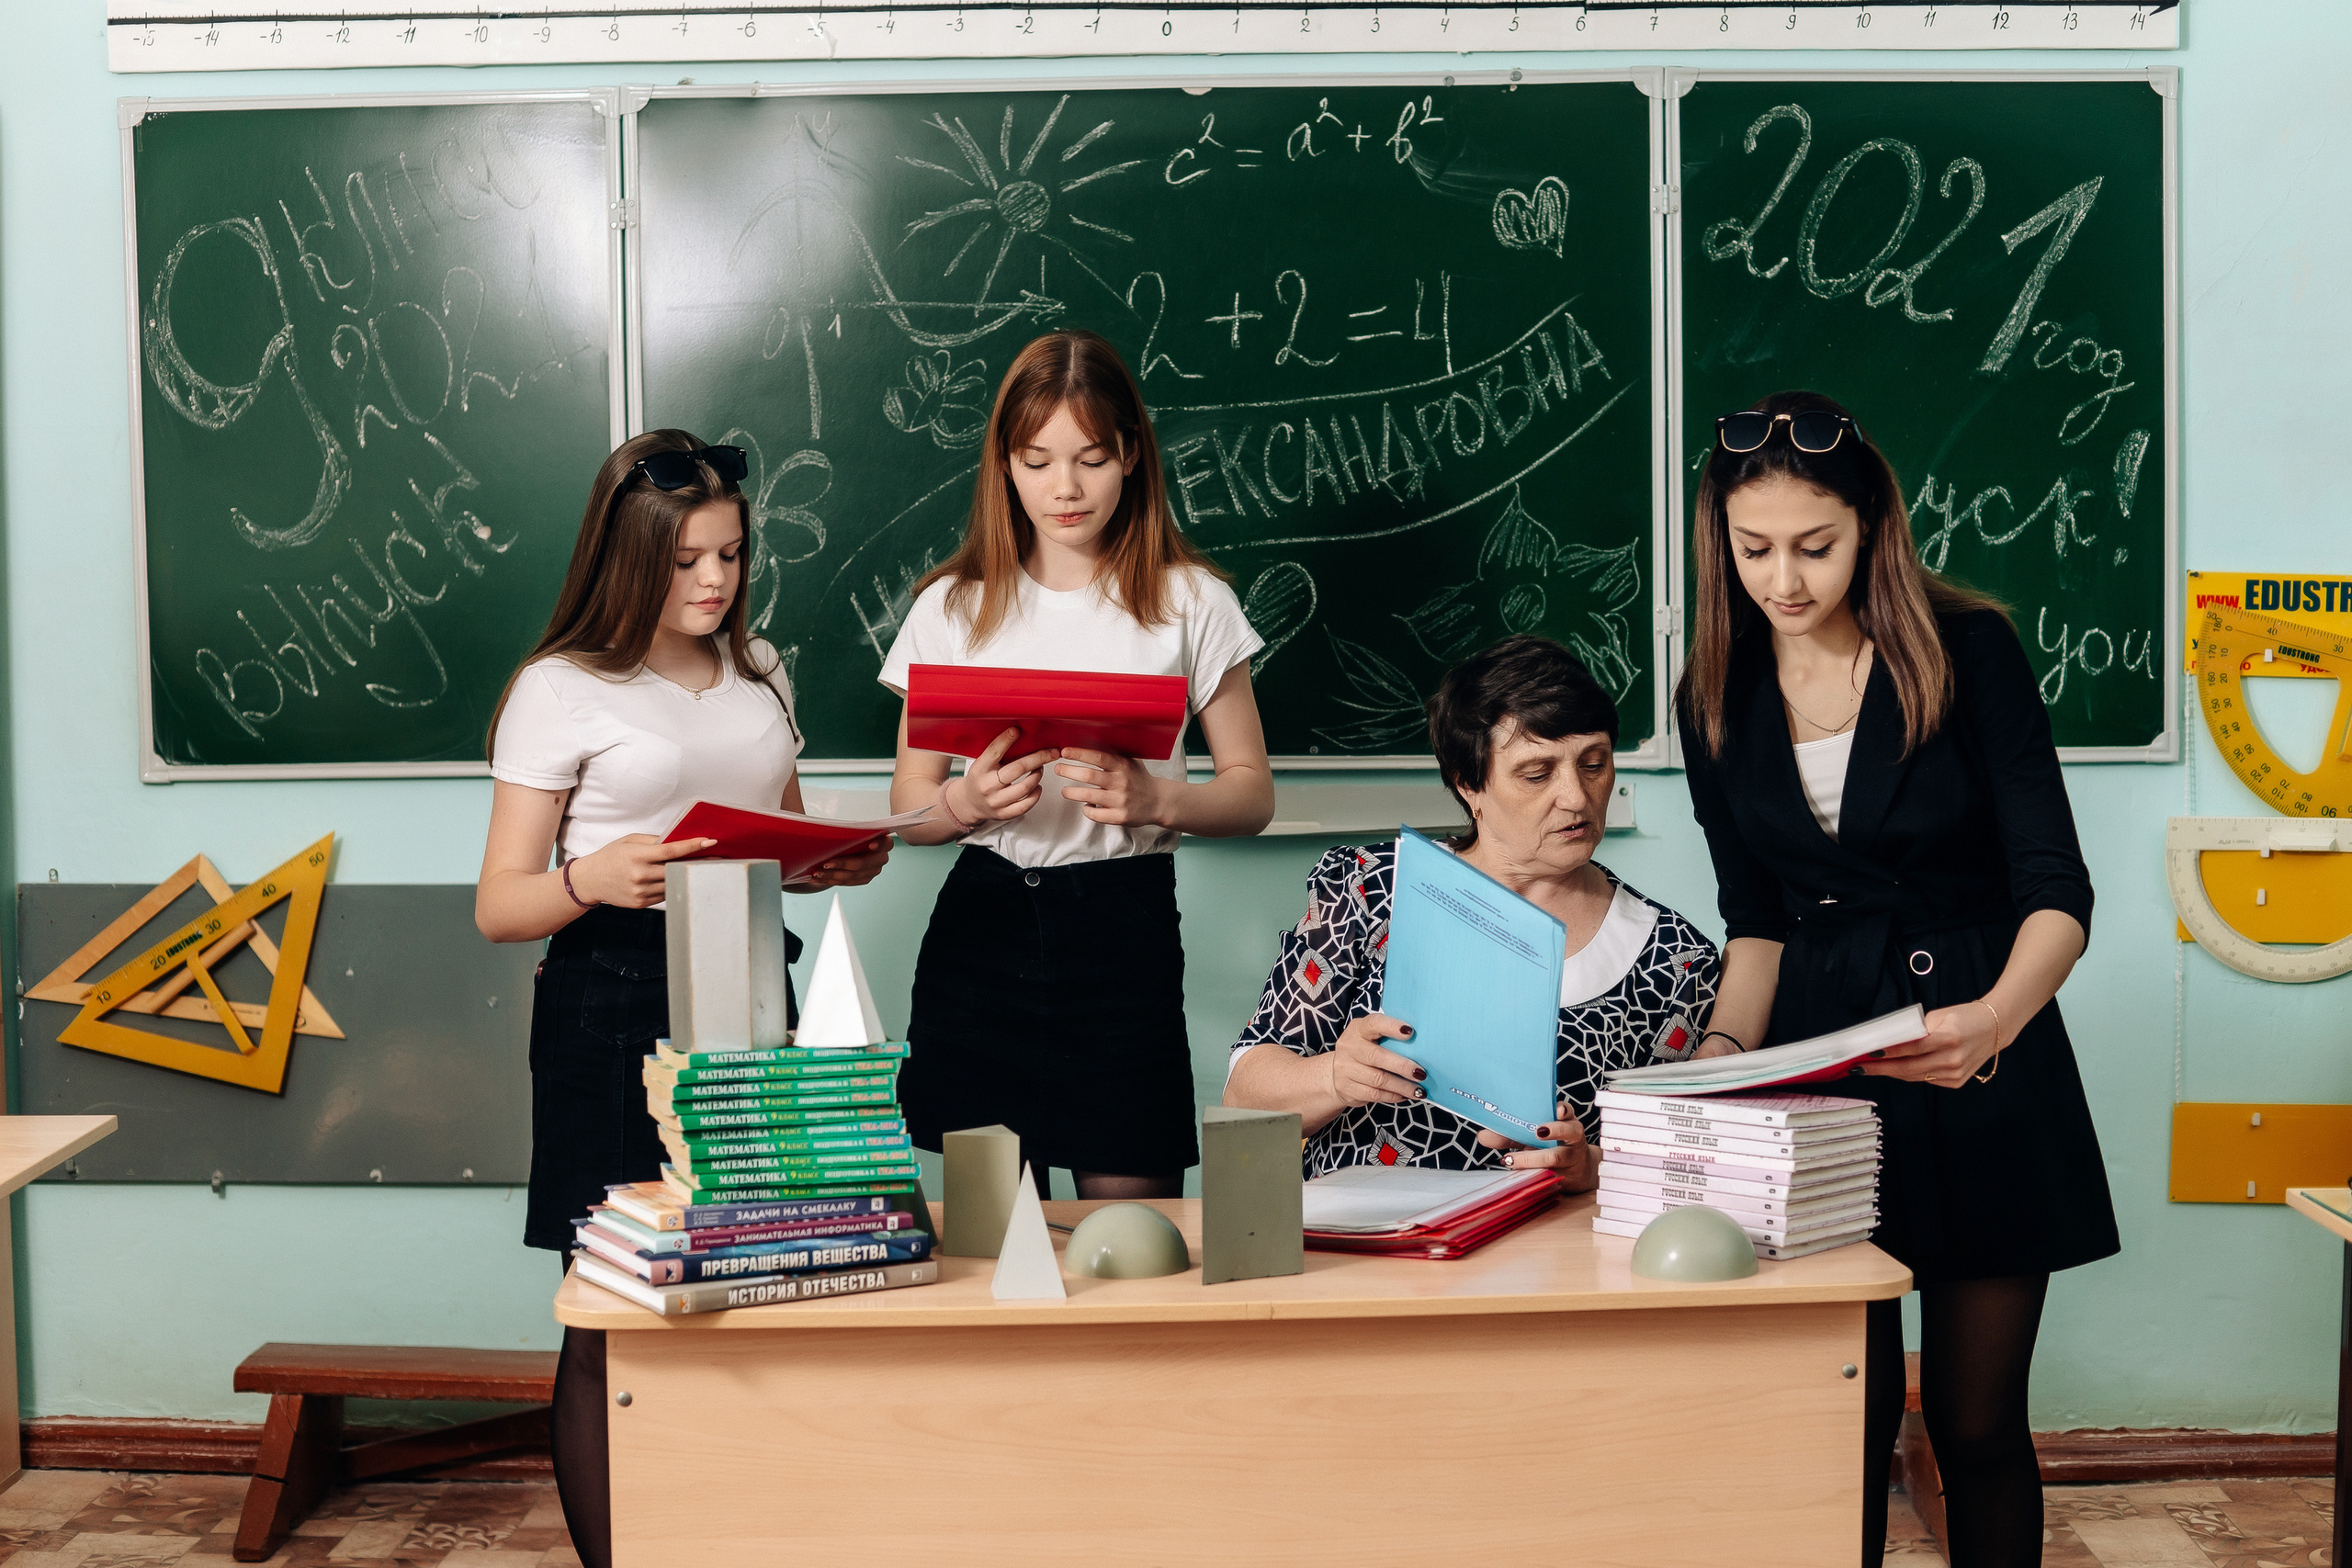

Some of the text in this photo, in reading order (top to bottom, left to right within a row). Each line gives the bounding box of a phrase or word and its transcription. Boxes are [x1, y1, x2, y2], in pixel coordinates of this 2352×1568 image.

[194, 30, 220, 46] -14
[259, 28, 282, 43] -13
[325, 27, 350, 43] -12
[395, 26, 416, 43] -11
[464, 25, 488, 42] -10
[533, 26, 550, 42] -9
[601, 23, 620, 40] -8
[672, 21, 687, 36] -7
[736, 20, 756, 38] -6
[876, 18, 895, 34] -4
[946, 17, 964, 32] -3
[1015, 17, 1035, 34] -2
[1083, 16, 1101, 34] -1
[1162, 20, 1171, 36] 0
[1233, 17, 1240, 33] 1
[1300, 18, 1311, 33] 2
[1370, 17, 1380, 33] 3
[1441, 17, 1451, 32] 4
[1509, 17, 1521, 32] 5
[1576, 17, 1587, 32] 6
[1649, 17, 1659, 32] 7
[1720, 16, 1729, 32] 8
[1785, 15, 1796, 31] 9
[1855, 12, 1871, 28] 10
[1924, 11, 1937, 28] 11
[1991, 12, 2010, 29] 12
[2063, 13, 2078, 30] 13
[2129, 13, 2146, 31] 14
[1348, 123, 1373, 153] +
[1702, 102, 2104, 372] 2021
[1127, 269, 1205, 381] 2
[1204, 290, 1264, 349] +
[1275, 268, 1340, 367] 2
[1414, 269, 1454, 377] 4
[330, 223, 594, 448] 2021
[1167, 311, 1612, 533] ЕКСАНДРОВНА
[1908, 427, 2153, 574] уск!
[2267, 627, 2278, 637] 40
[2333, 644, 2344, 653] 30
[2221, 648, 2229, 658] 10
[2278, 645, 2321, 663] EDUSTRONG
[2220, 672, 2228, 684] 20
[2208, 644, 2217, 660] 170
[2233, 748, 2246, 763] 130
[2250, 769, 2265, 784] 120
[2271, 787, 2285, 800] 110
[2294, 801, 2309, 813] 100
[2321, 805, 2337, 818] 90
[2244, 743, 2255, 755] 50
[2260, 762, 2272, 774] 60
[2279, 779, 2291, 790] 70
[2301, 792, 2313, 802] 80
[95, 851, 325, 1006] 10 20 30 40 50
[708, 1052, 776, 1064] МАТЕМАТИКА
[697, 1067, 765, 1080] МАТЕМАТИКА
[692, 1083, 761, 1096] МАТЕМАТИКА
[692, 1099, 761, 1111] МАТЕМАТИКА
[1660, 1101, 1686, 1113] РУССКИЙ
[700, 1113, 768, 1126] МАТЕМАТИКА
[1668, 1116, 1692, 1128] РУССКИЙ
[701, 1128, 770, 1140] МАТЕМАТИКА
[1674, 1133, 1700, 1145] РУССКИЙ
[707, 1143, 776, 1156] МАТЕМАТИКА
[1668, 1151, 1696, 1162] РУССКИЙ
[711, 1157, 779, 1170] МАТЕМАТИКА
[1662, 1160, 1687, 1172] РУССКИЙ
[718, 1172, 787, 1185] МАТЕМАТИКА
[1664, 1172, 1690, 1185] РУССКИЙ
[711, 1189, 780, 1201] МАТЕМАТИКА
[1661, 1187, 1686, 1200] РУССКИЙ
[735, 1209, 781, 1222] ЗАДАЧИ
[783, 1207, 799, 1217] НА
[801, 1201, 857, 1215] СМЕКАЛКУ
[733, 1227, 812, 1243] ЗАНИМАТЕЛЬНАЯ
[814, 1222, 884, 1235] ИНФОРМАТИКА
[701, 1244, 888, 1277] ПРЕВРАЩЕНИЯ ВЕЩЕСТВА
[727, 1272, 886, 1305] ИСТОРИЯ ОТЕЧЕСТВА
